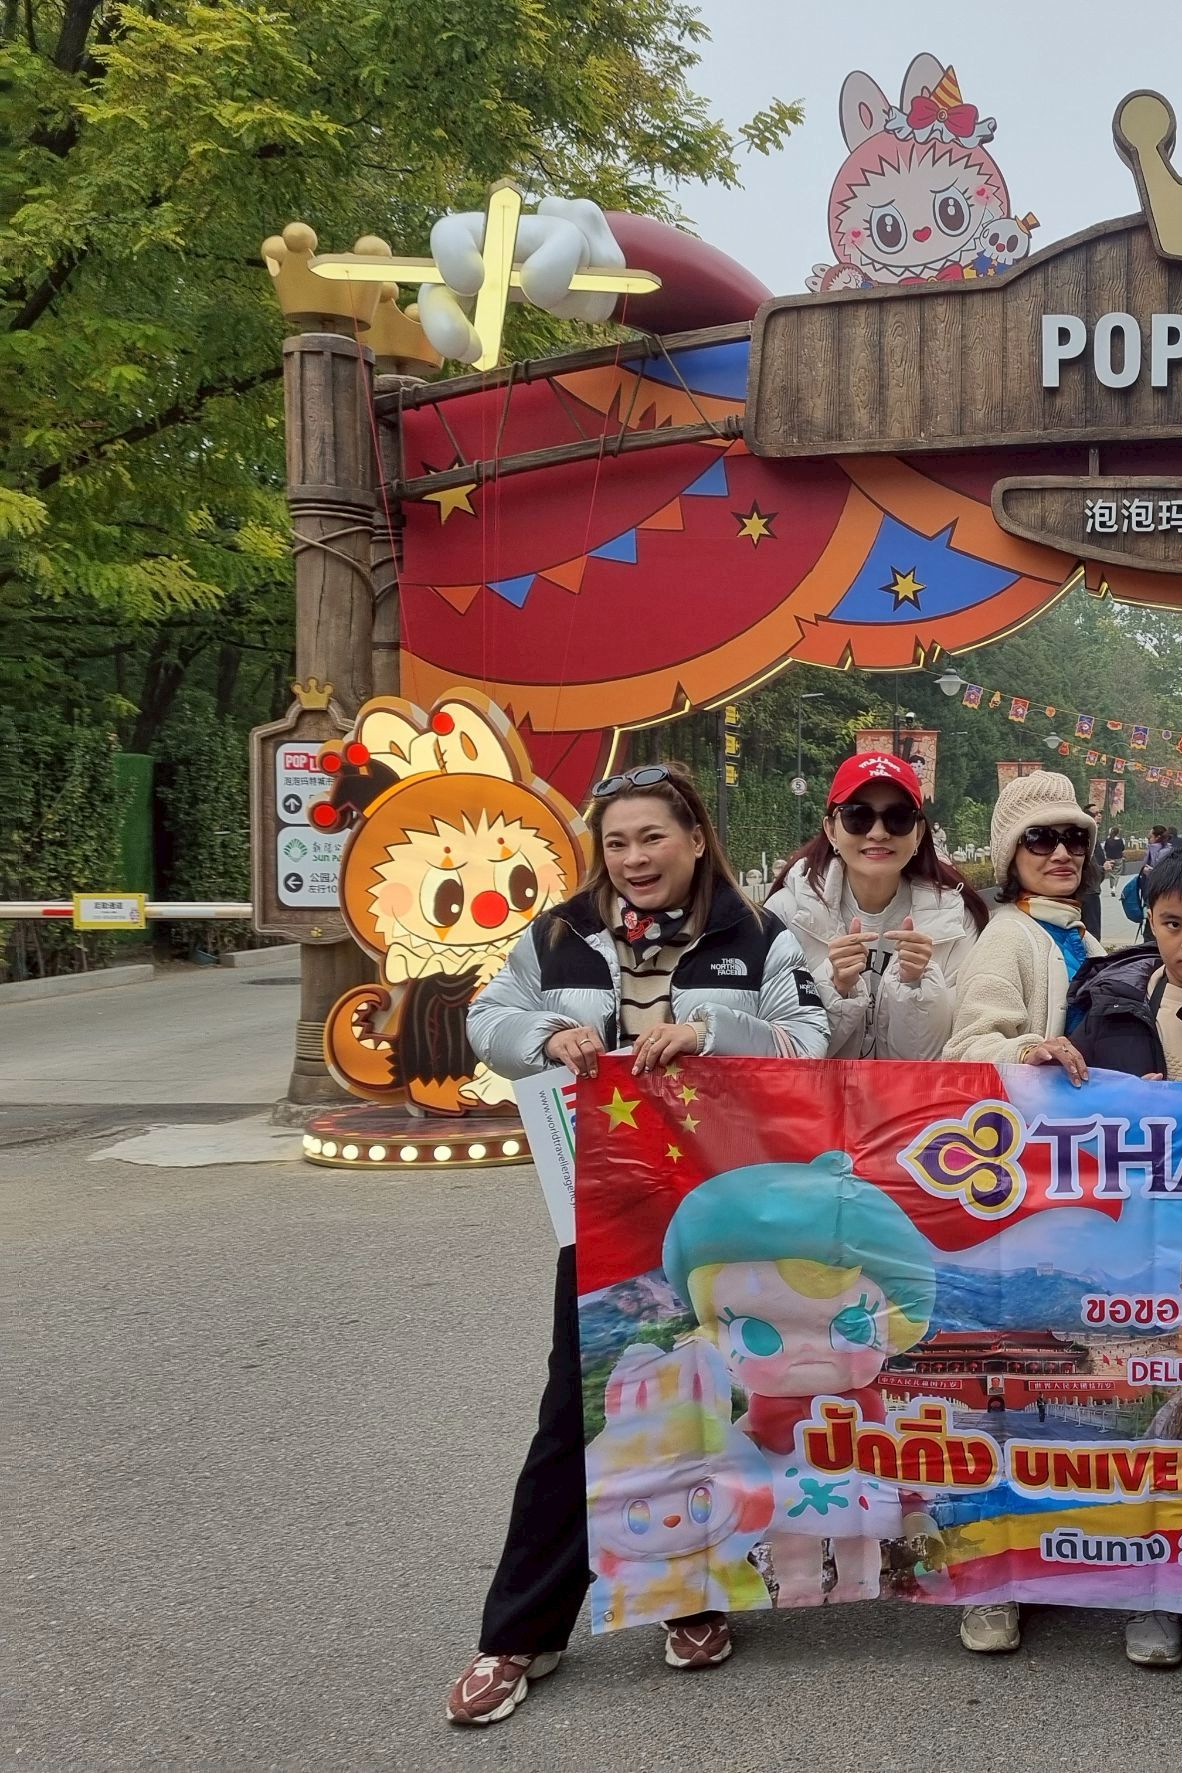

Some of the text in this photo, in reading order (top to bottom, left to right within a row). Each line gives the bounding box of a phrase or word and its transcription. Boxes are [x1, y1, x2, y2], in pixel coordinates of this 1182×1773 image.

[284, 754, 307, 768] POP
[795, 781, 802, 789] 5
[803, 1405, 996, 1486] ปักกิ่ง
[1045, 1529, 1166, 1563] เดินทาง
